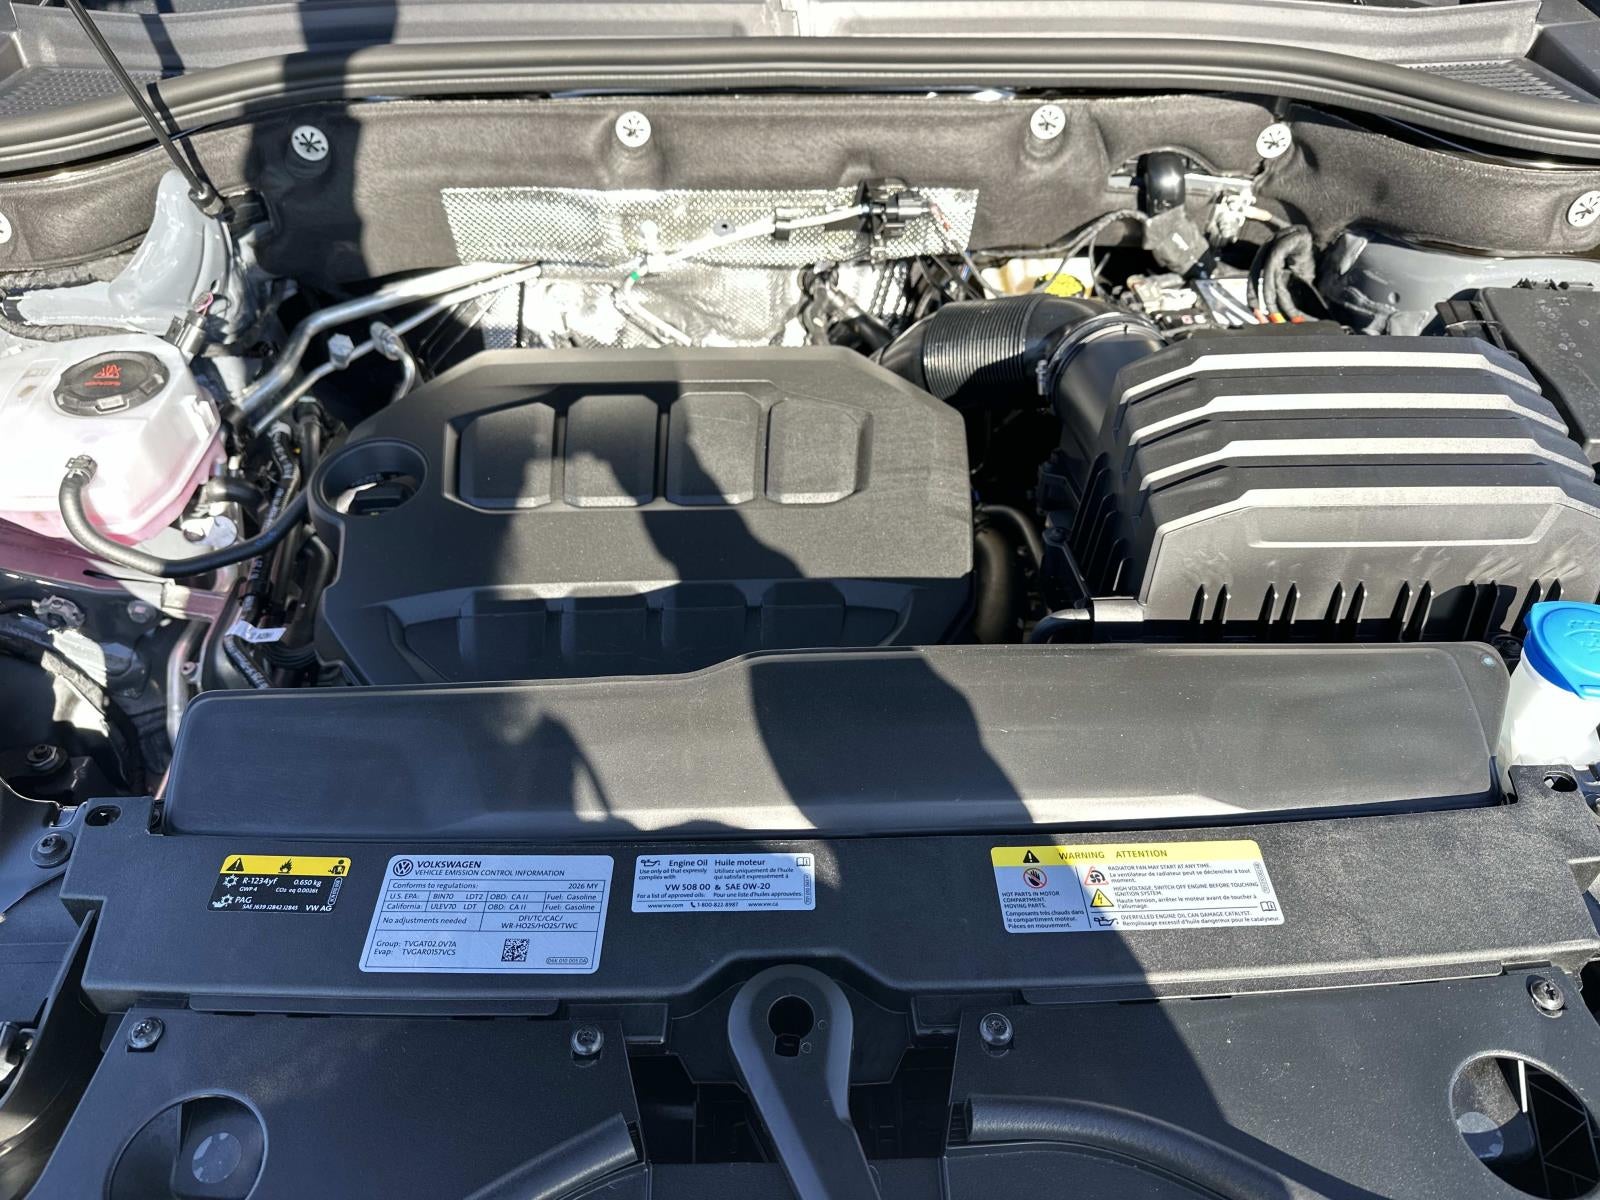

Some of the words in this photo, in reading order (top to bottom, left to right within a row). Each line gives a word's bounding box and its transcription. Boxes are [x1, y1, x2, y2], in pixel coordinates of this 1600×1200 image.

[1059, 852, 1105, 860] WARNING
[1116, 850, 1168, 859] ATTENTION
[669, 860, 695, 868] Engine
[242, 877, 278, 885] R-1234yf
[313, 880, 322, 888] kg
[436, 883, 479, 891] regulations:
[394, 917, 439, 925] adjustments
